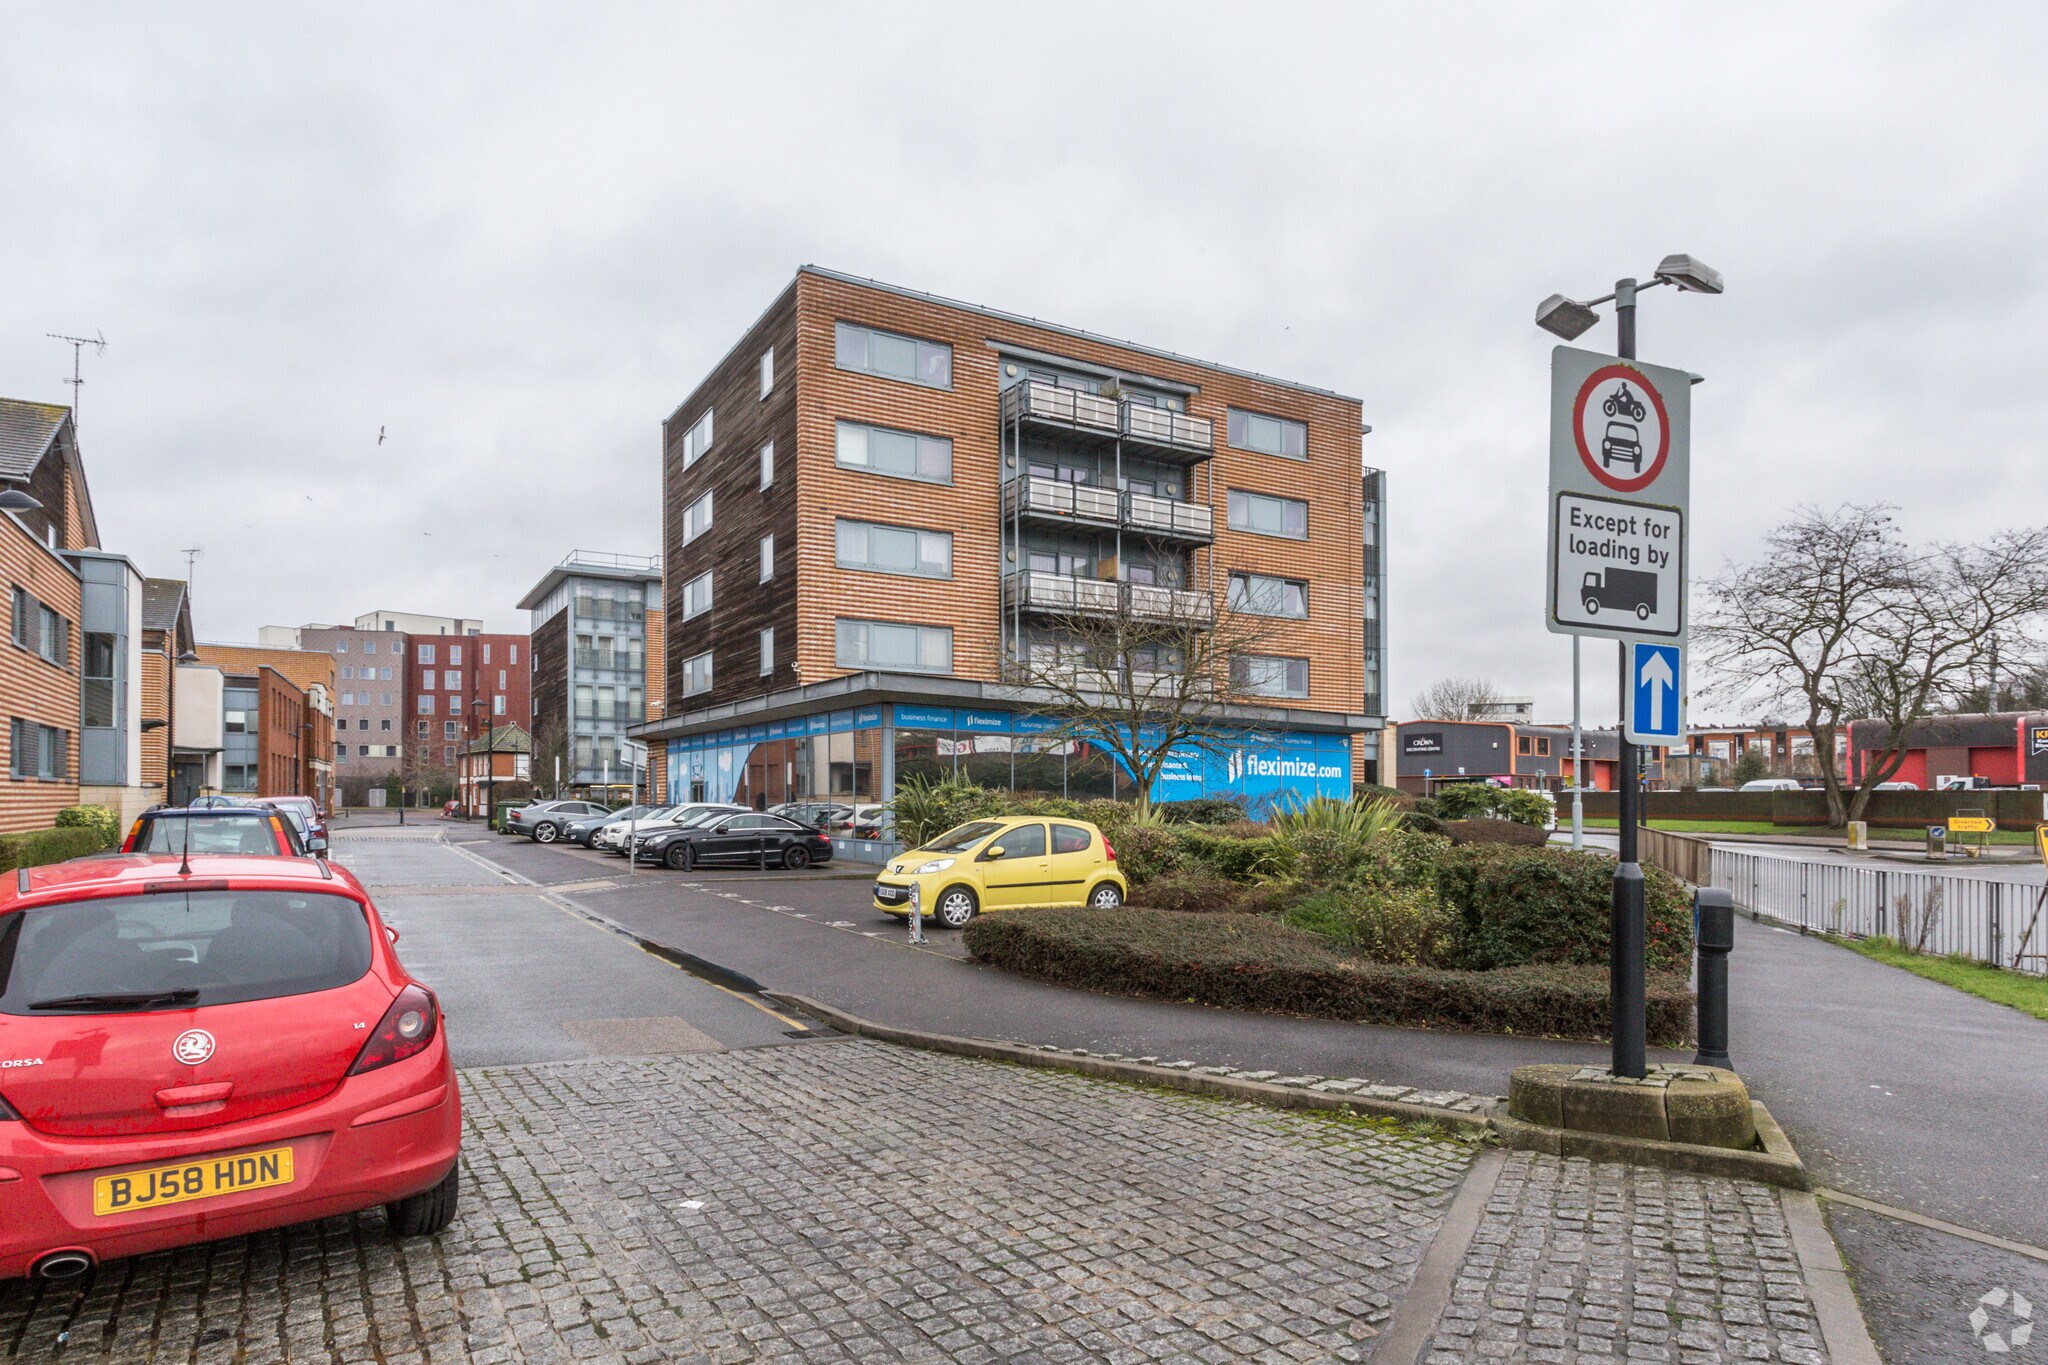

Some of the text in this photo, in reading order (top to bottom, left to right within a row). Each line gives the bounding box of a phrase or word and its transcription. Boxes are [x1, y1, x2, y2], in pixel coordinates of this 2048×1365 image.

[1570, 506, 1670, 539] Except for
[1569, 533, 1669, 569] loading by
[901, 713, 948, 724] business finance
[974, 717, 1002, 726] fleximize
[1021, 720, 1043, 729] business
[1247, 754, 1342, 778] fleximize.com
[1161, 772, 1185, 780] business
[0, 1057, 44, 1068] ORSA
[110, 1153, 279, 1208] BJ58 HDN
